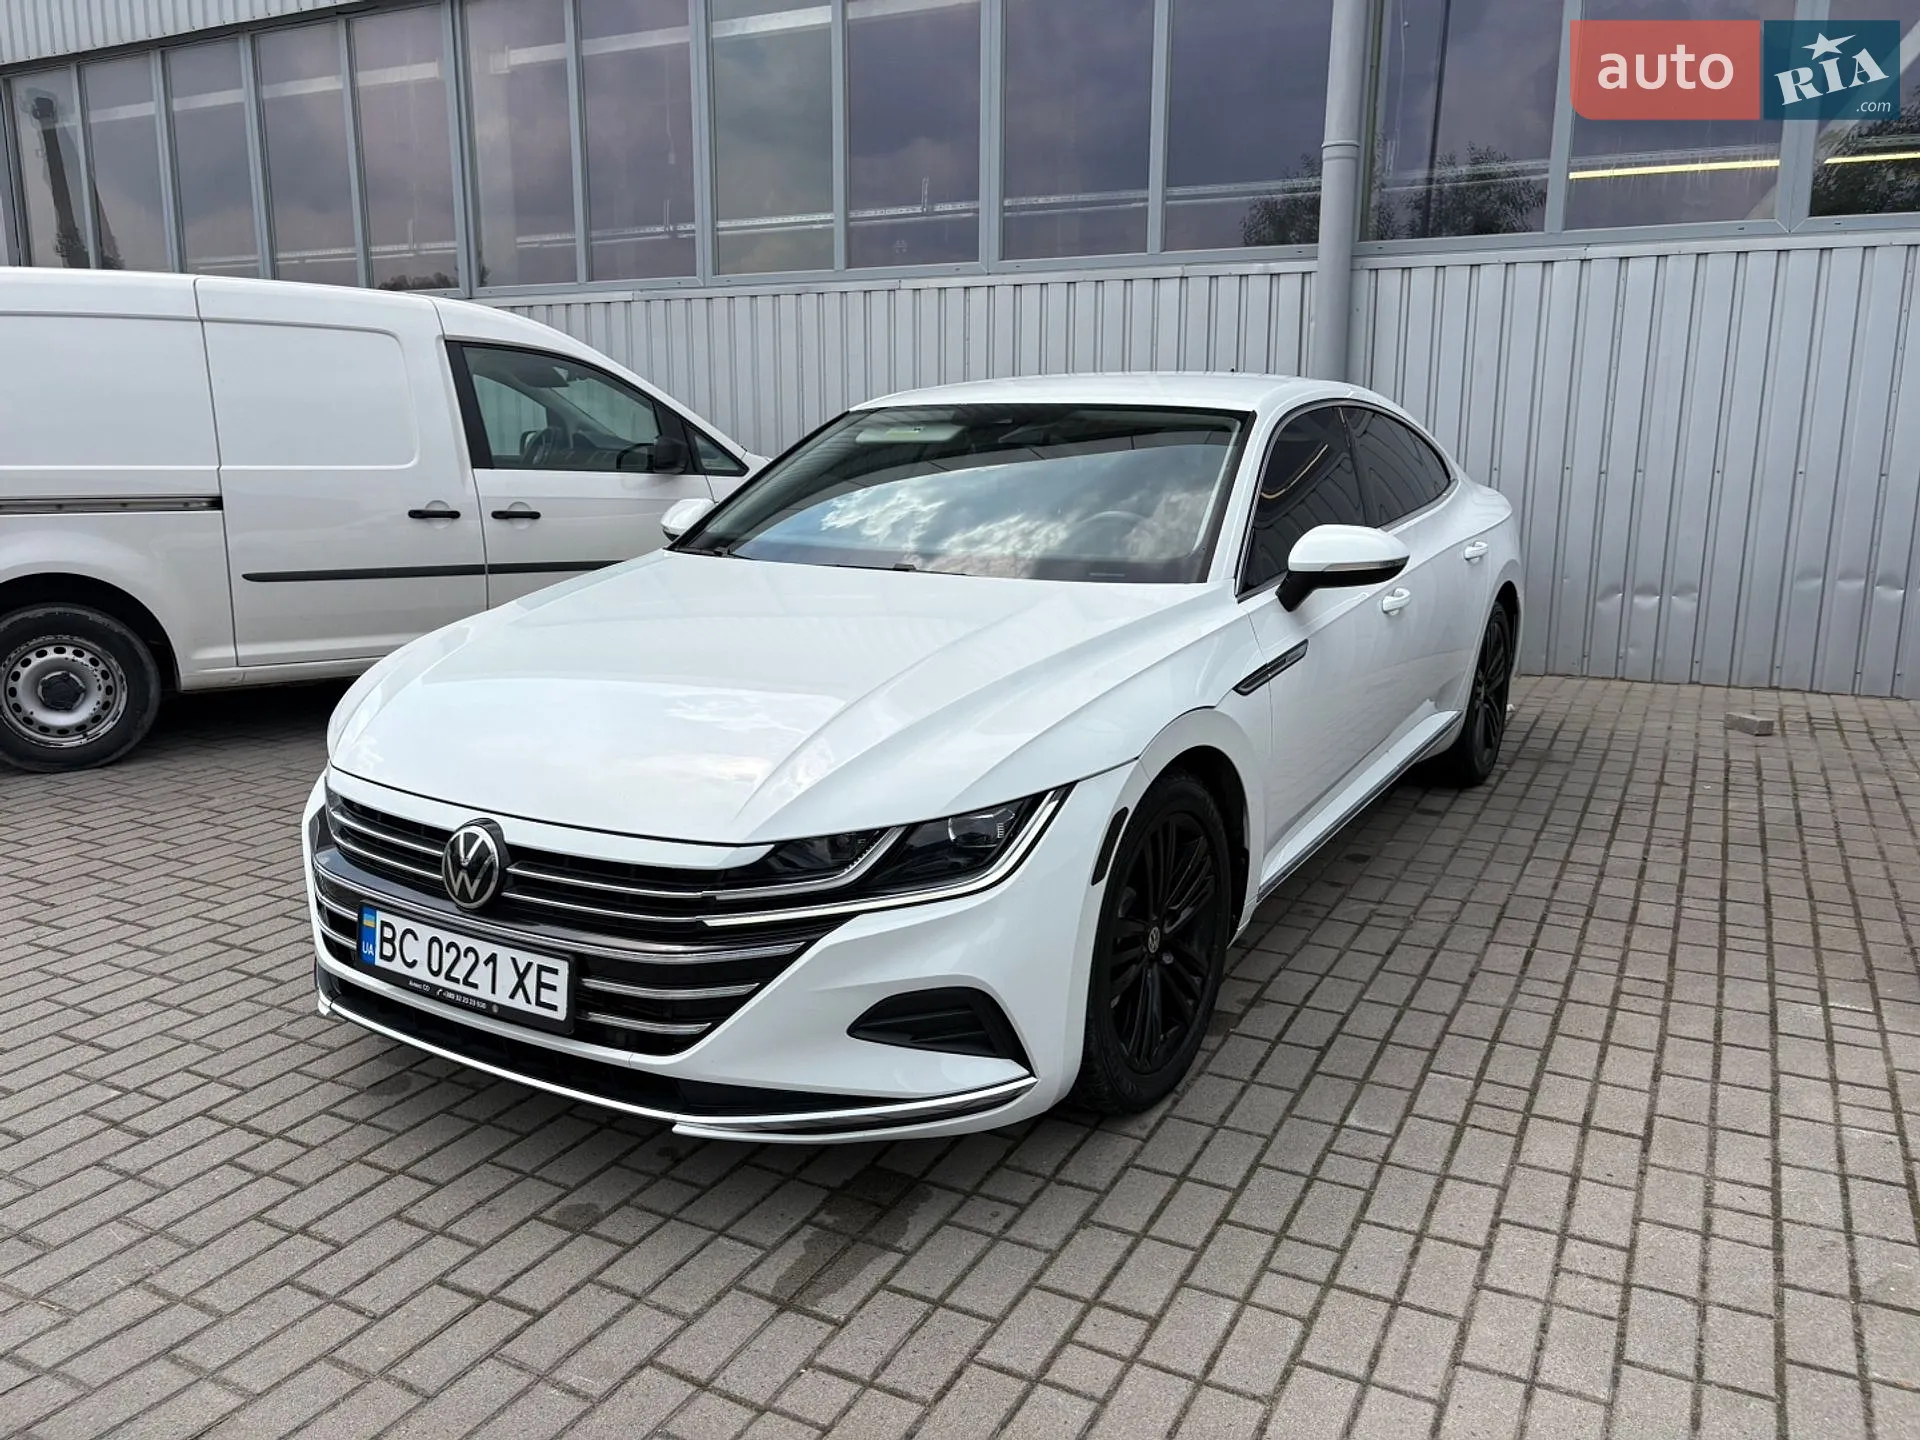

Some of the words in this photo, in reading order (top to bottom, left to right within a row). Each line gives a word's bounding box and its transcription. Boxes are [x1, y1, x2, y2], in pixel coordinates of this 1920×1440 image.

[362, 941, 375, 956] UA
[379, 919, 419, 969] BC
[427, 935, 498, 995] 0221
[508, 956, 559, 1012] XE
